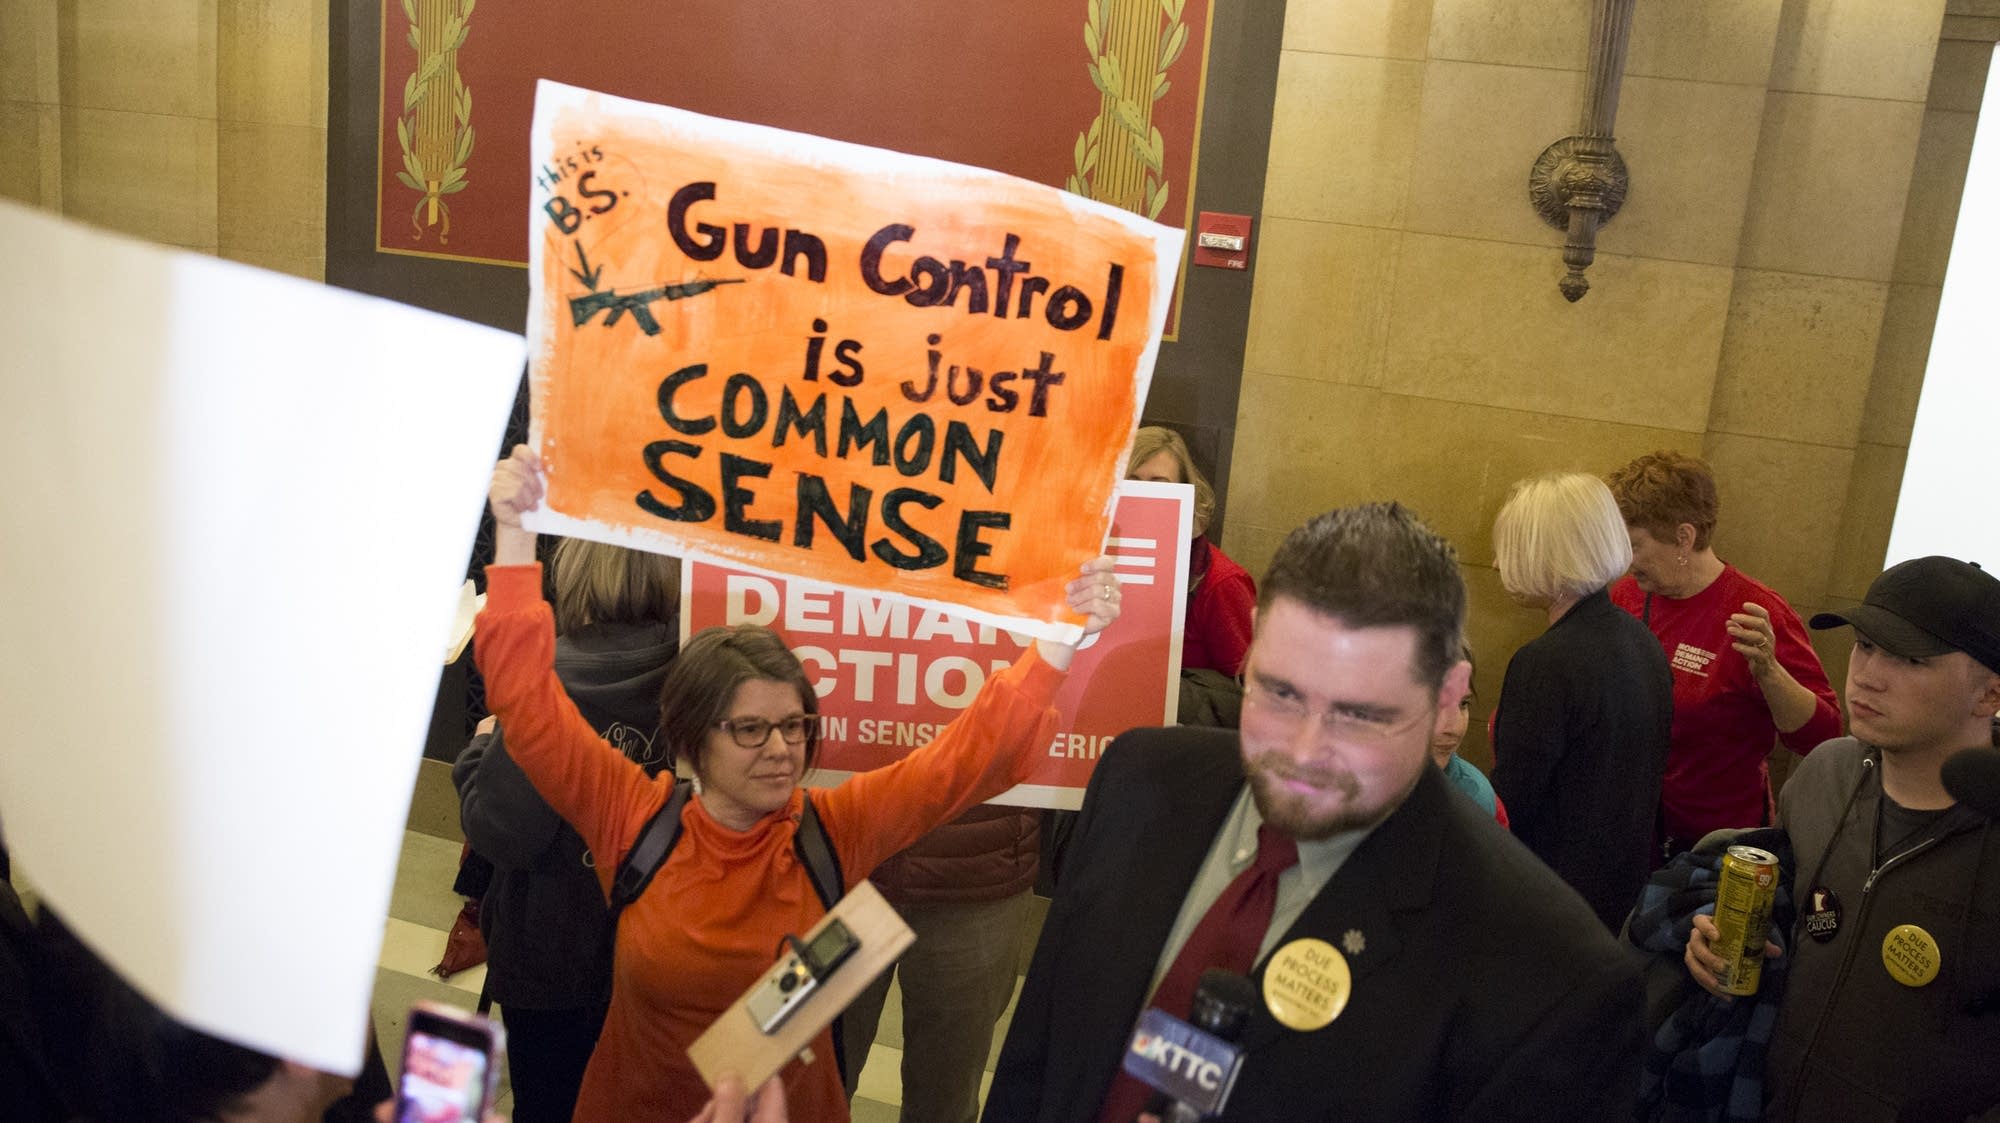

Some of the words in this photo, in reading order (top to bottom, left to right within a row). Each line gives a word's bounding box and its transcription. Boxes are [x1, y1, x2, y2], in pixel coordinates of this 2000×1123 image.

[537, 156, 578, 192] this
[576, 141, 603, 164] is
[544, 170, 629, 235] B.S.
[667, 181, 828, 283] Gun
[860, 223, 1124, 341] Control
[802, 319, 864, 388] is
[900, 334, 1065, 417] just
[656, 364, 1004, 494] COMMON
[635, 439, 1011, 592] SENSE
[726, 574, 1101, 650] DEMA
[788, 645, 1013, 710] CTIO
[1807, 918, 1837, 932] CAUCUS
[1893, 934, 1931, 968] PROCESS
[1908, 932, 1928, 951] DUE
[1283, 956, 1338, 994] PROCESS
[1305, 948, 1331, 970] DUE
[1888, 944, 1925, 977] MATTERS
[1275, 972, 1328, 1011] MATTERS
[1151, 1034, 1223, 1091] KTTC
